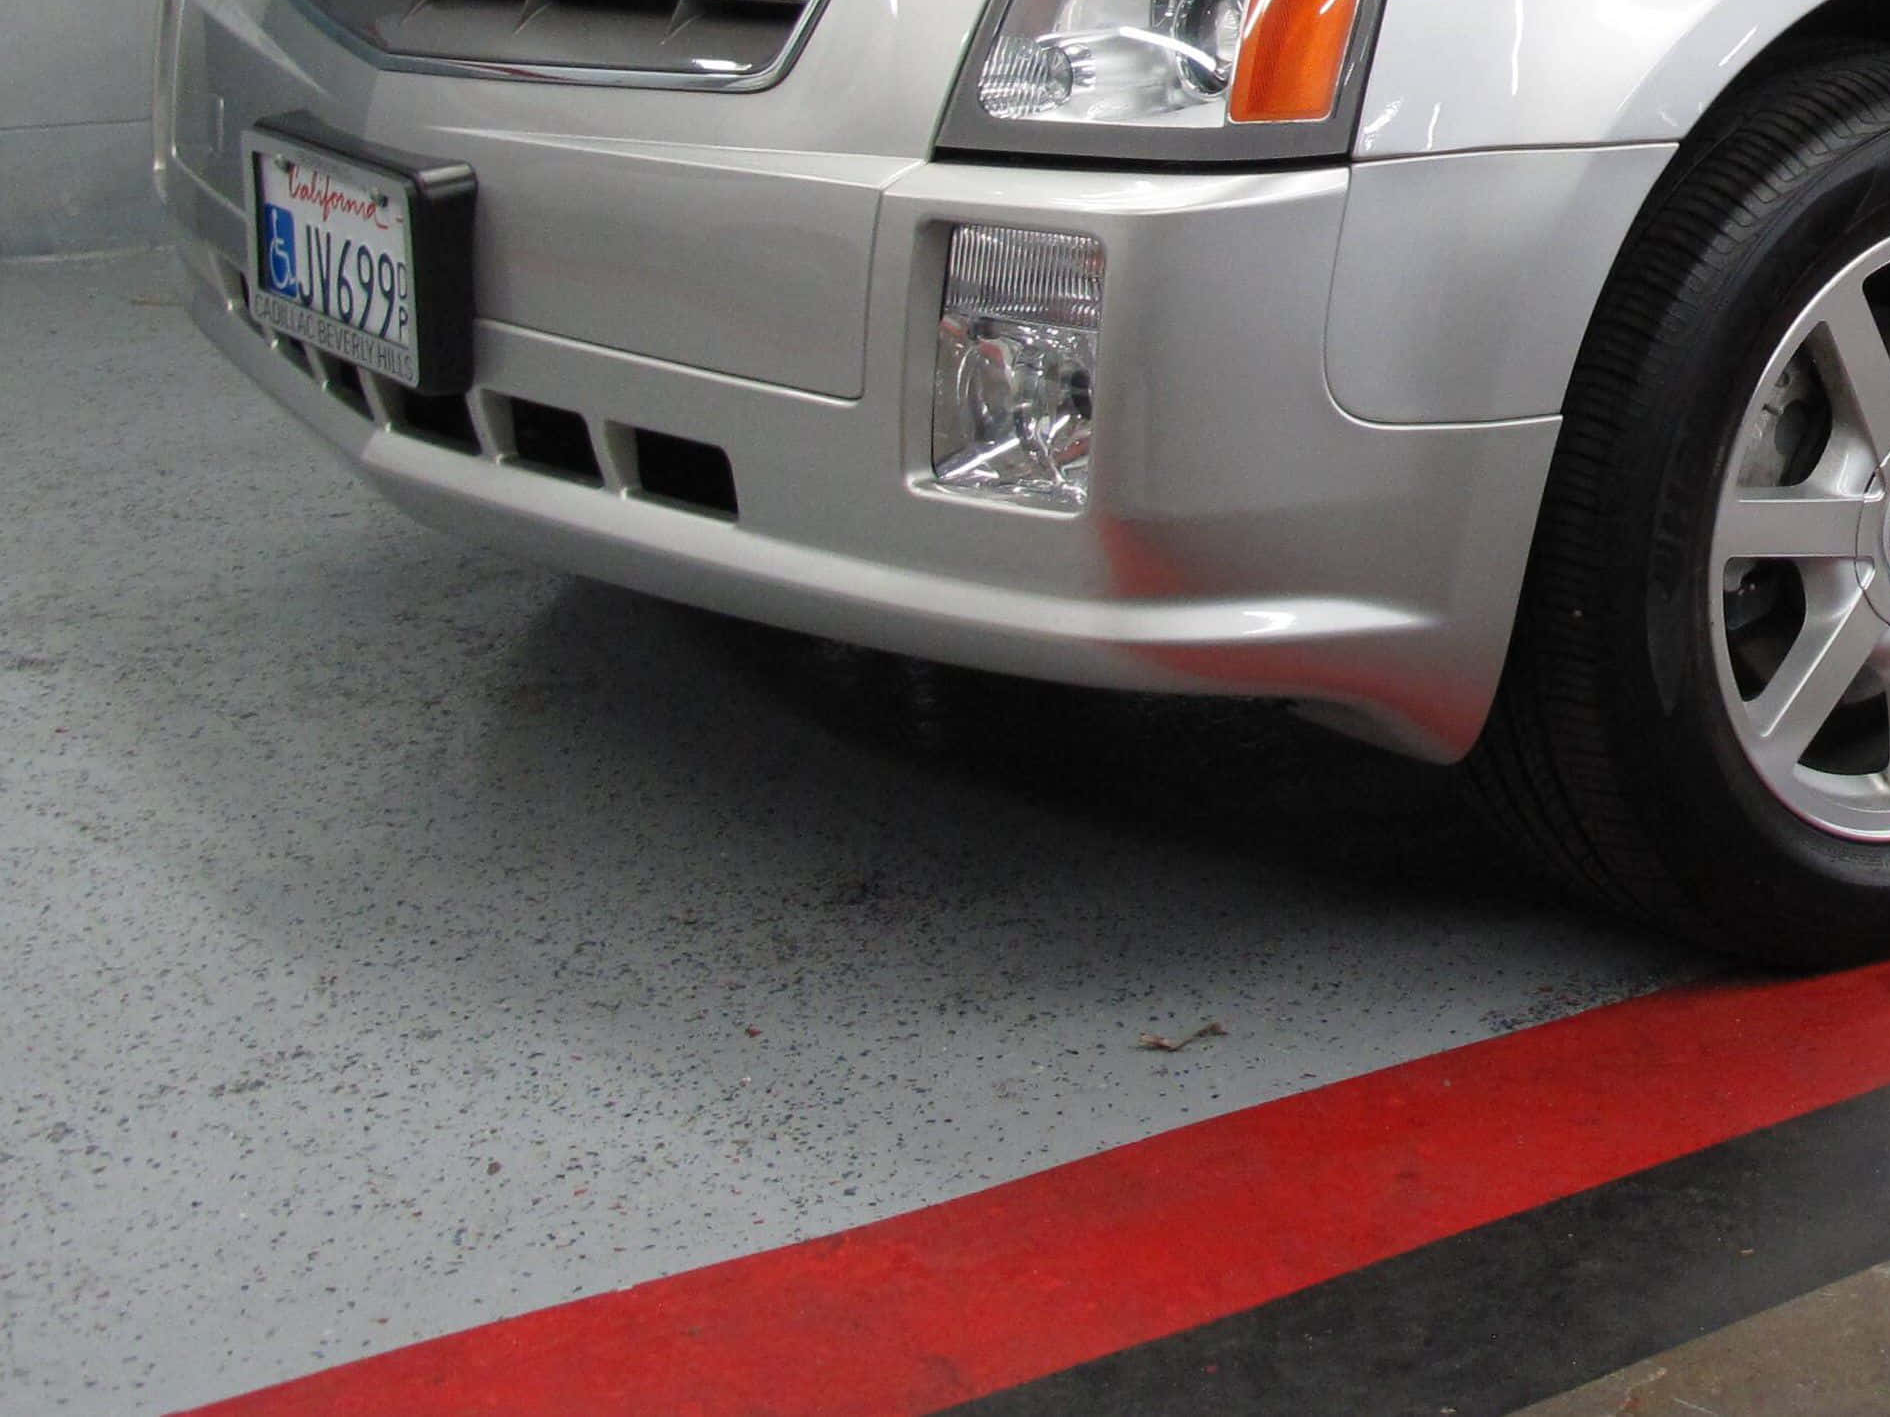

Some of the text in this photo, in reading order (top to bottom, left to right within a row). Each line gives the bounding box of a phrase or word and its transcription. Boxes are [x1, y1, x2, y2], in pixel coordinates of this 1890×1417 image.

[288, 164, 388, 230] California
[297, 224, 396, 339] JV699
[254, 292, 415, 382] CADILLAC BEVERLY HILLS
